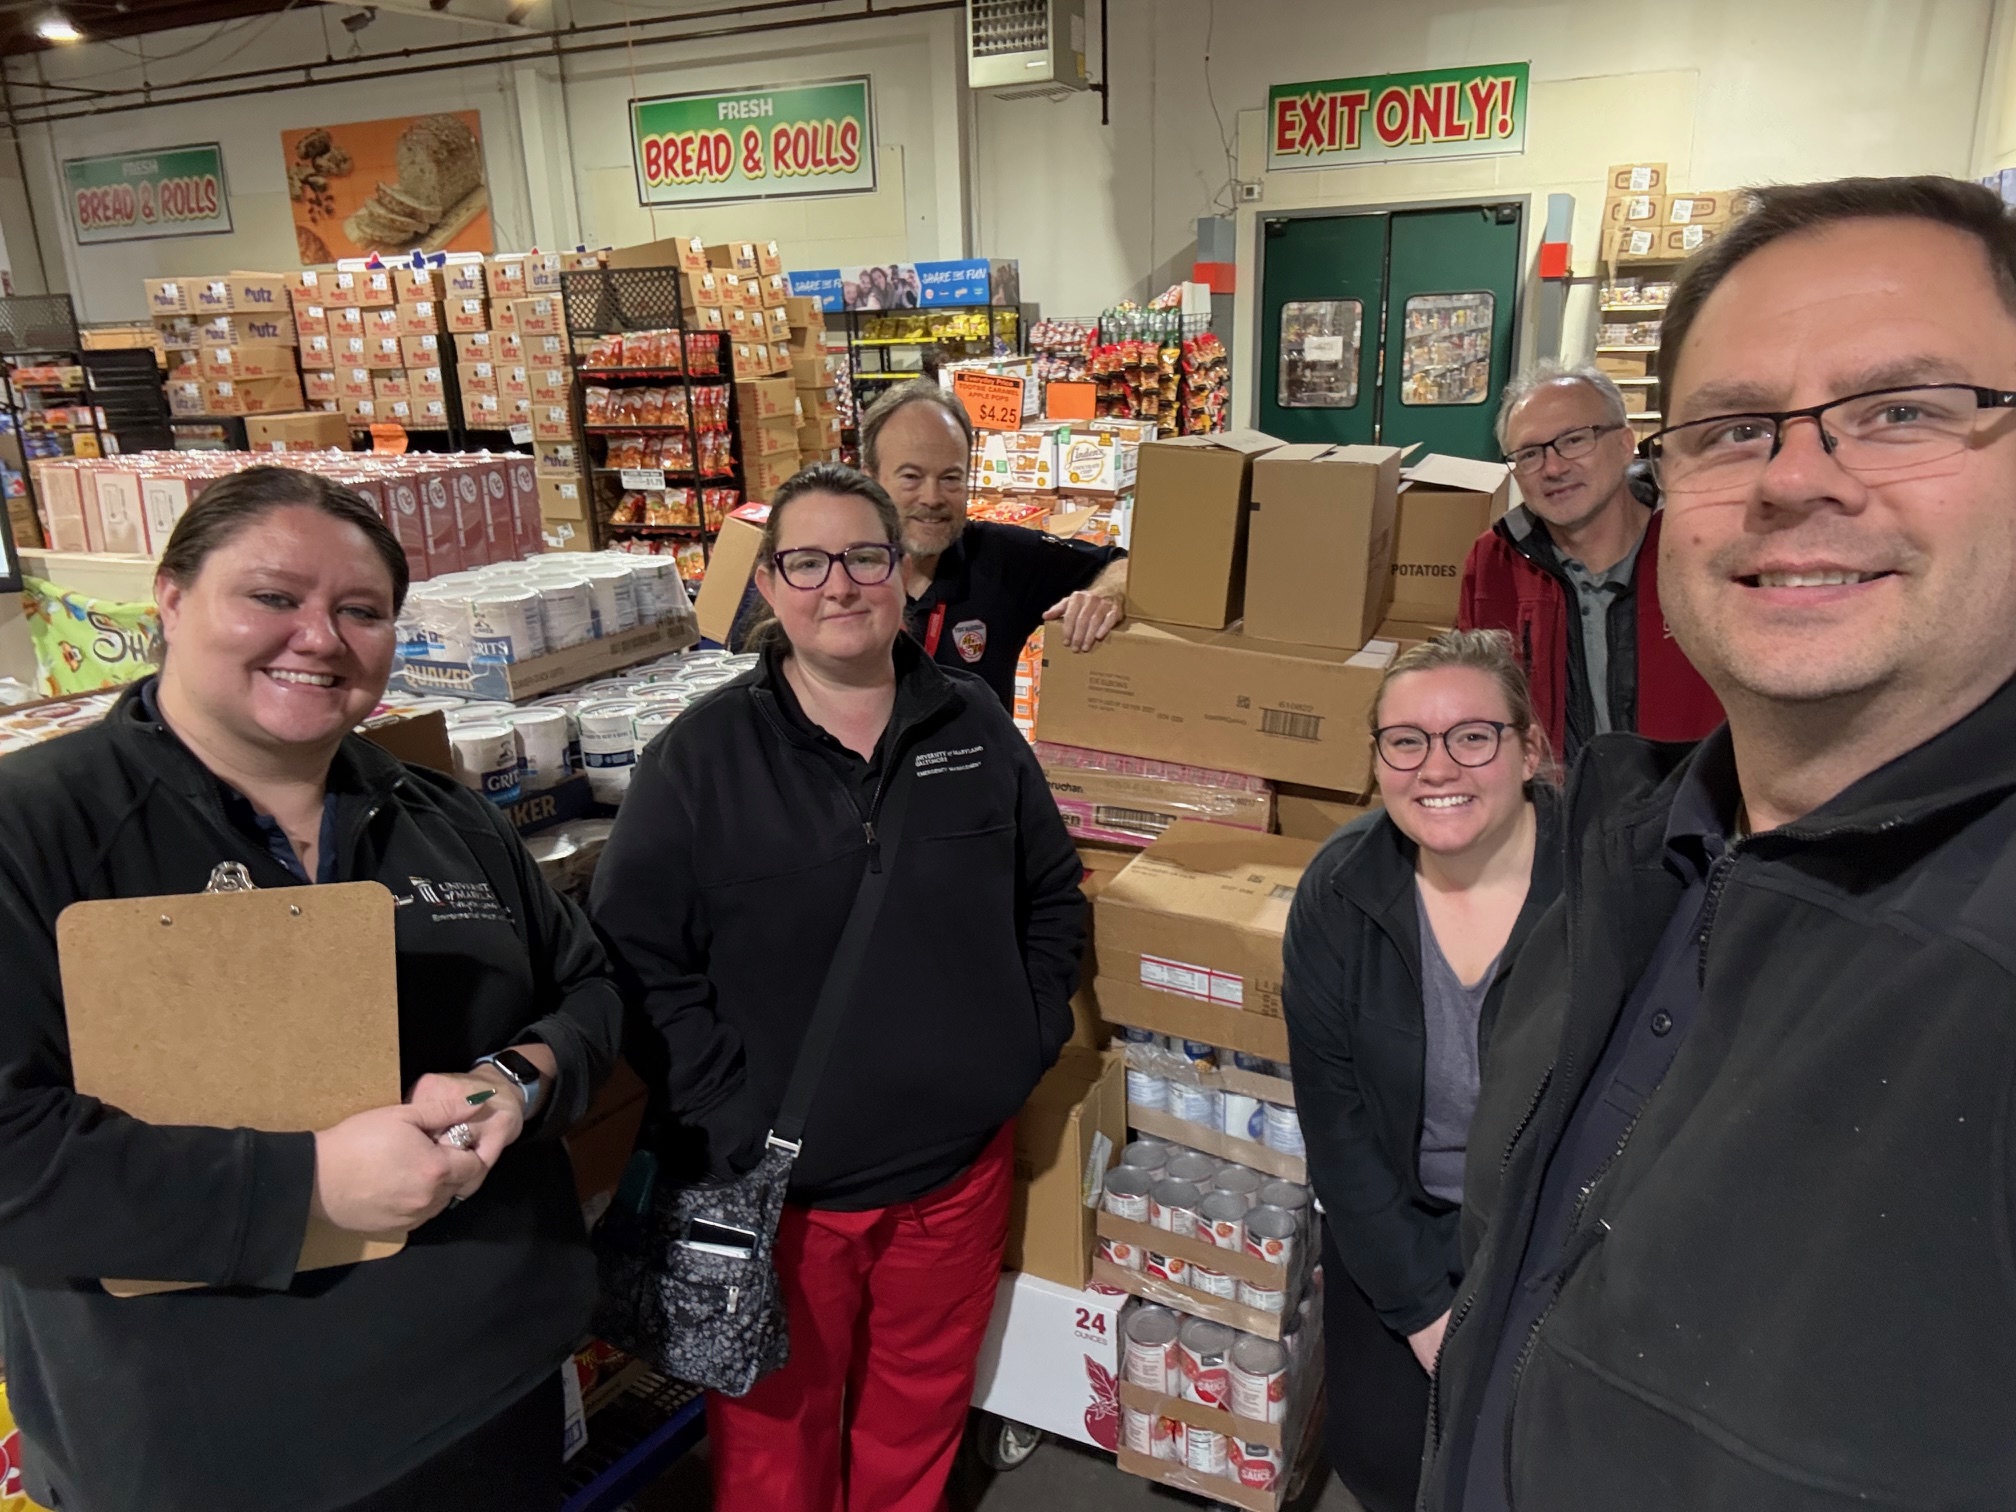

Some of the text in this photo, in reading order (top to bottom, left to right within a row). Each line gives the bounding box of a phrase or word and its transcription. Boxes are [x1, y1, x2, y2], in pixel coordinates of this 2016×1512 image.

[718, 99, 774, 121] FRESH
[1276, 79, 1513, 153] EXIT ONLY!
[643, 119, 860, 183] BREAD & ROLLS
[77, 175, 219, 228] BREAD & ROLLS
[794, 280, 820, 292] SHARE
[921, 270, 952, 284] SHARE
[966, 268, 988, 280] FUN
[980, 404, 1017, 424] $4.25
[1390, 564, 1458, 578] POTATOES
[487, 768, 521, 792] GRIT
[1076, 1308, 1107, 1335] 24
[1074, 1330, 1108, 1346] OUNCES
